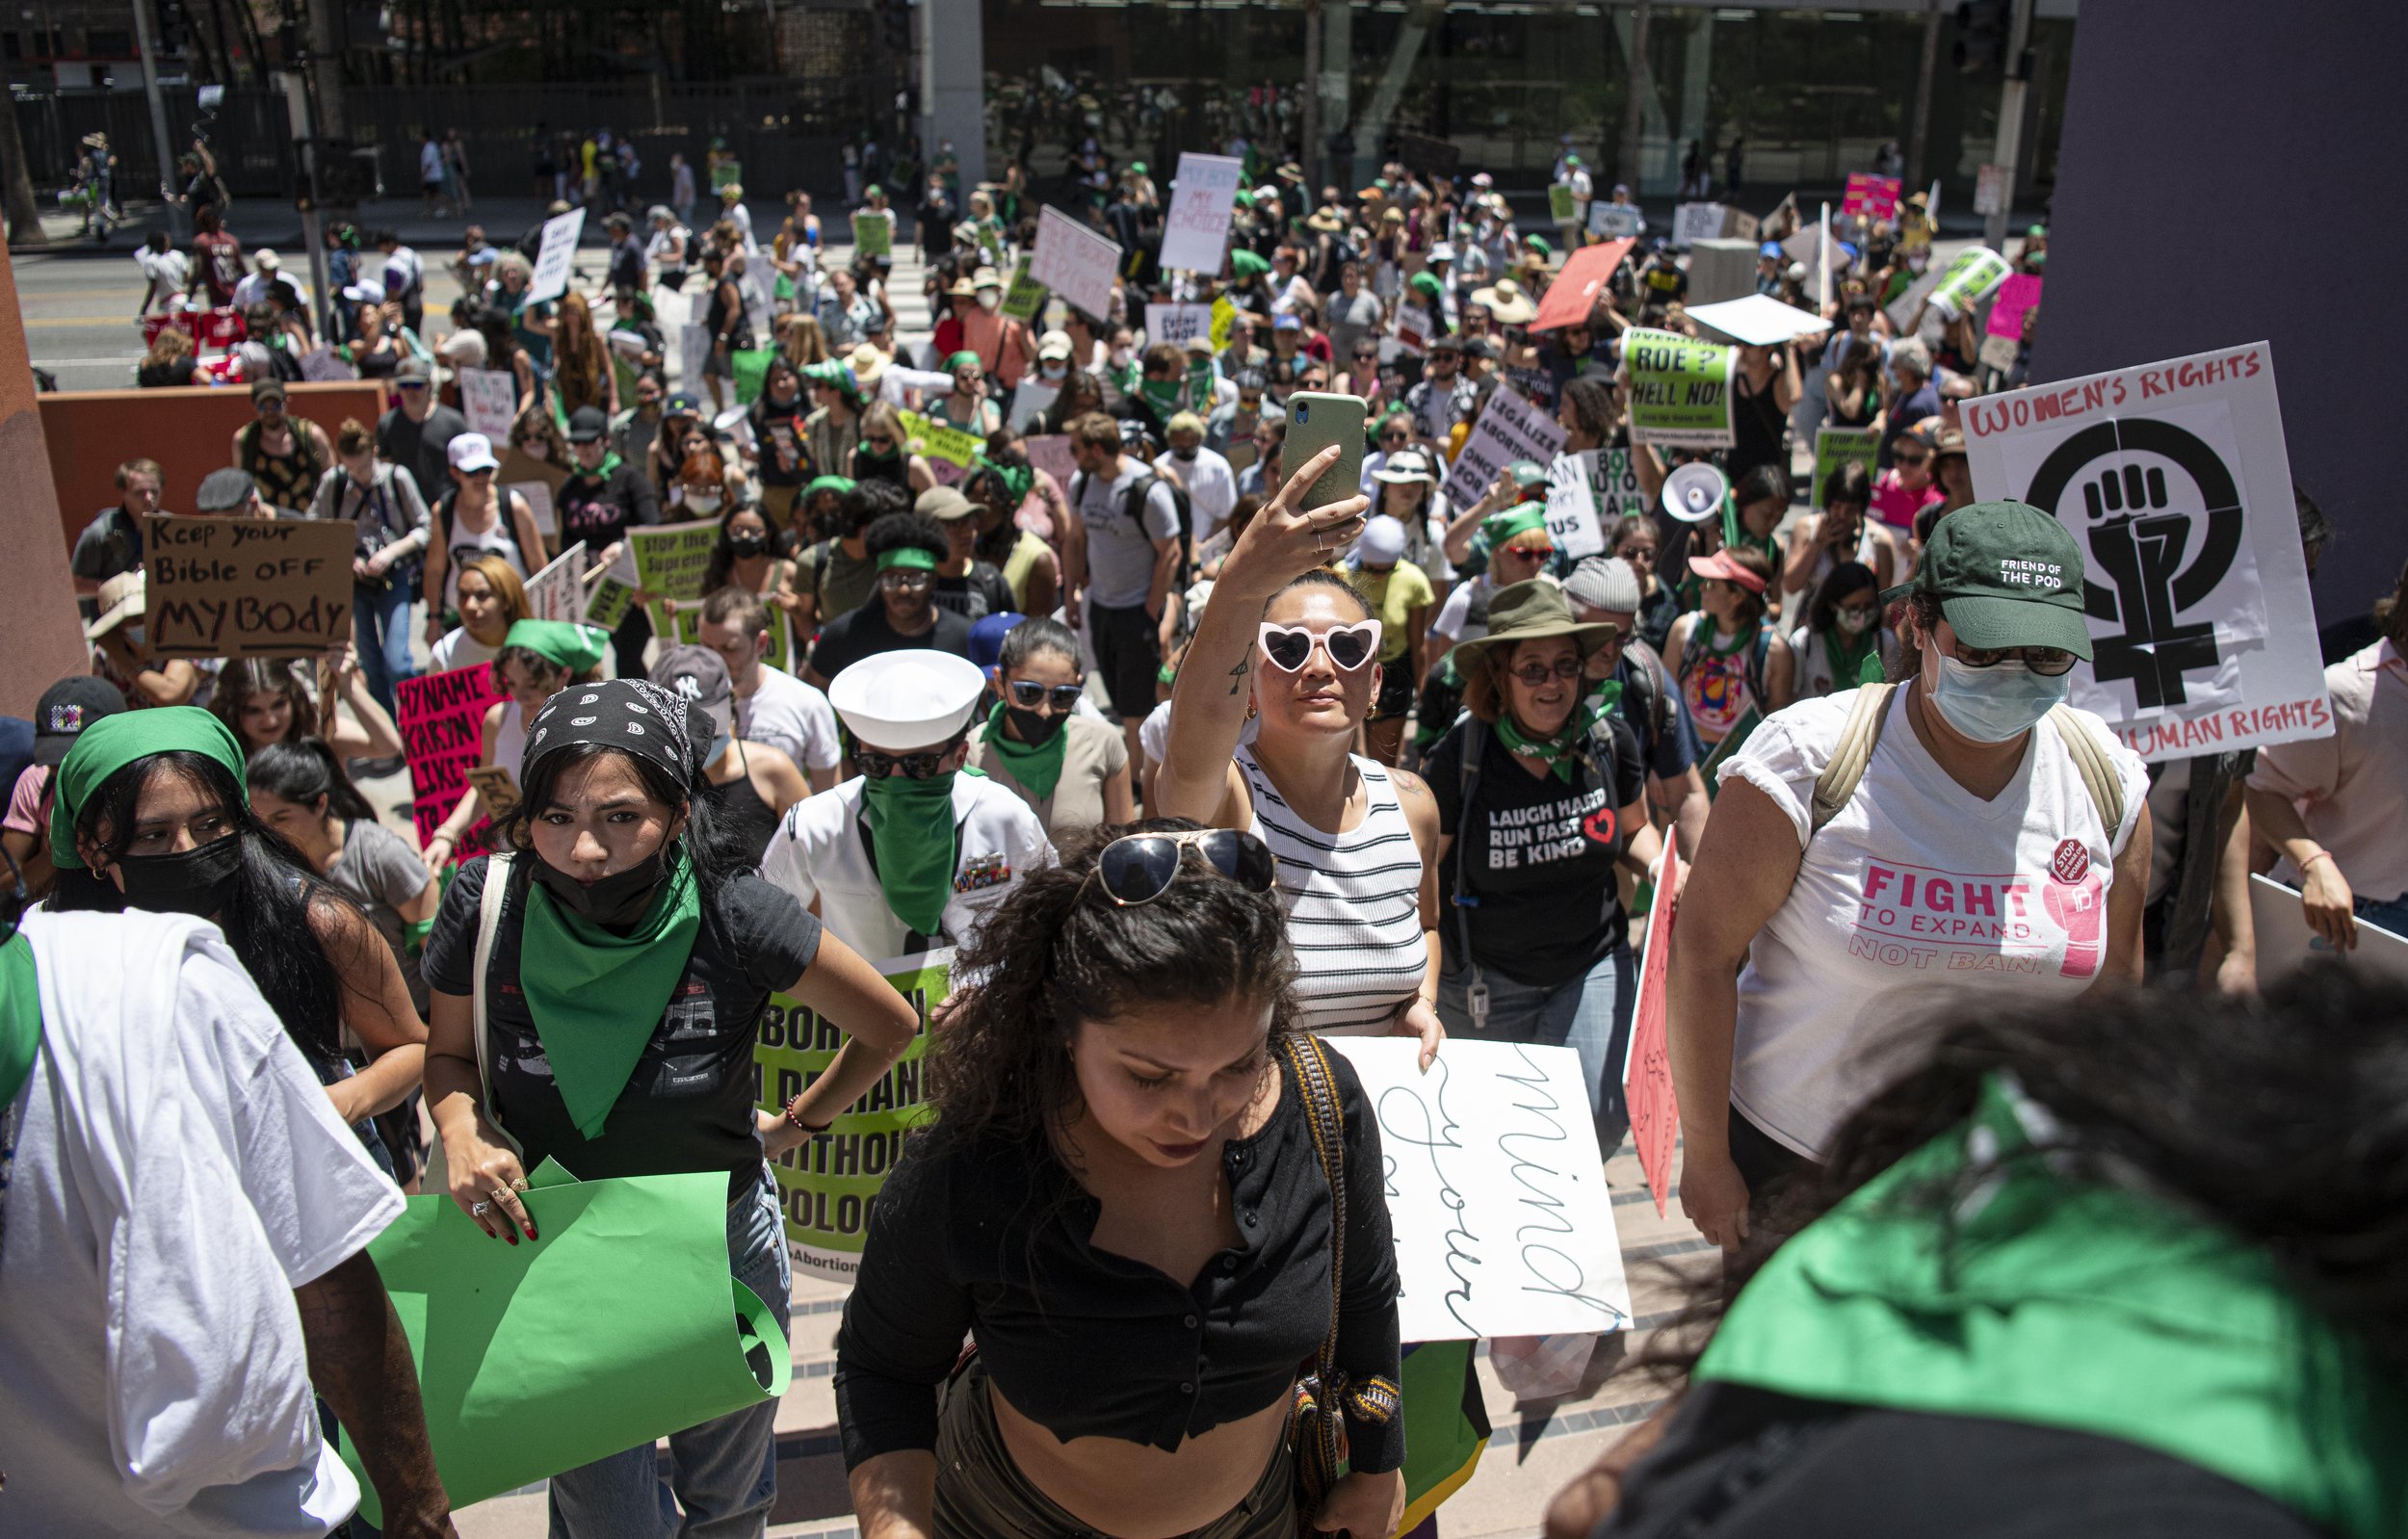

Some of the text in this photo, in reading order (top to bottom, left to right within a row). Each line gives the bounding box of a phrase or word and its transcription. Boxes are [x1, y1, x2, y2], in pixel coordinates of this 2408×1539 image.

[1636, 347, 1688, 372] ROE
[1633, 381, 1724, 405] HELL NO!
[1969, 351, 2261, 437] WOMEN'S RIGHTS
[1490, 396, 1558, 455] LEGALIZE
[151, 519, 296, 550] Keep your
[644, 534, 679, 553] STOP
[155, 556, 240, 585] Bible
[2000, 570, 2061, 588] THE POD
[2001, 560, 2061, 575] FRIEND OF
[151, 596, 227, 644] MY
[2119, 697, 2331, 757] UMAN RIGHTS
[409, 758, 463, 798] LIKE
[1489, 788, 1607, 827] LAUGH HARD
[1489, 817, 1581, 848] RUN FAST
[1489, 836, 1587, 870] BE KIND
[2056, 841, 2075, 869] STOP
[2067, 853, 2087, 879] WOMEN
[2060, 864, 2071, 876] THE
[1863, 865, 2030, 917] FIGHT
[1861, 903, 1896, 926] TO
[1848, 933, 1938, 970] NOT
